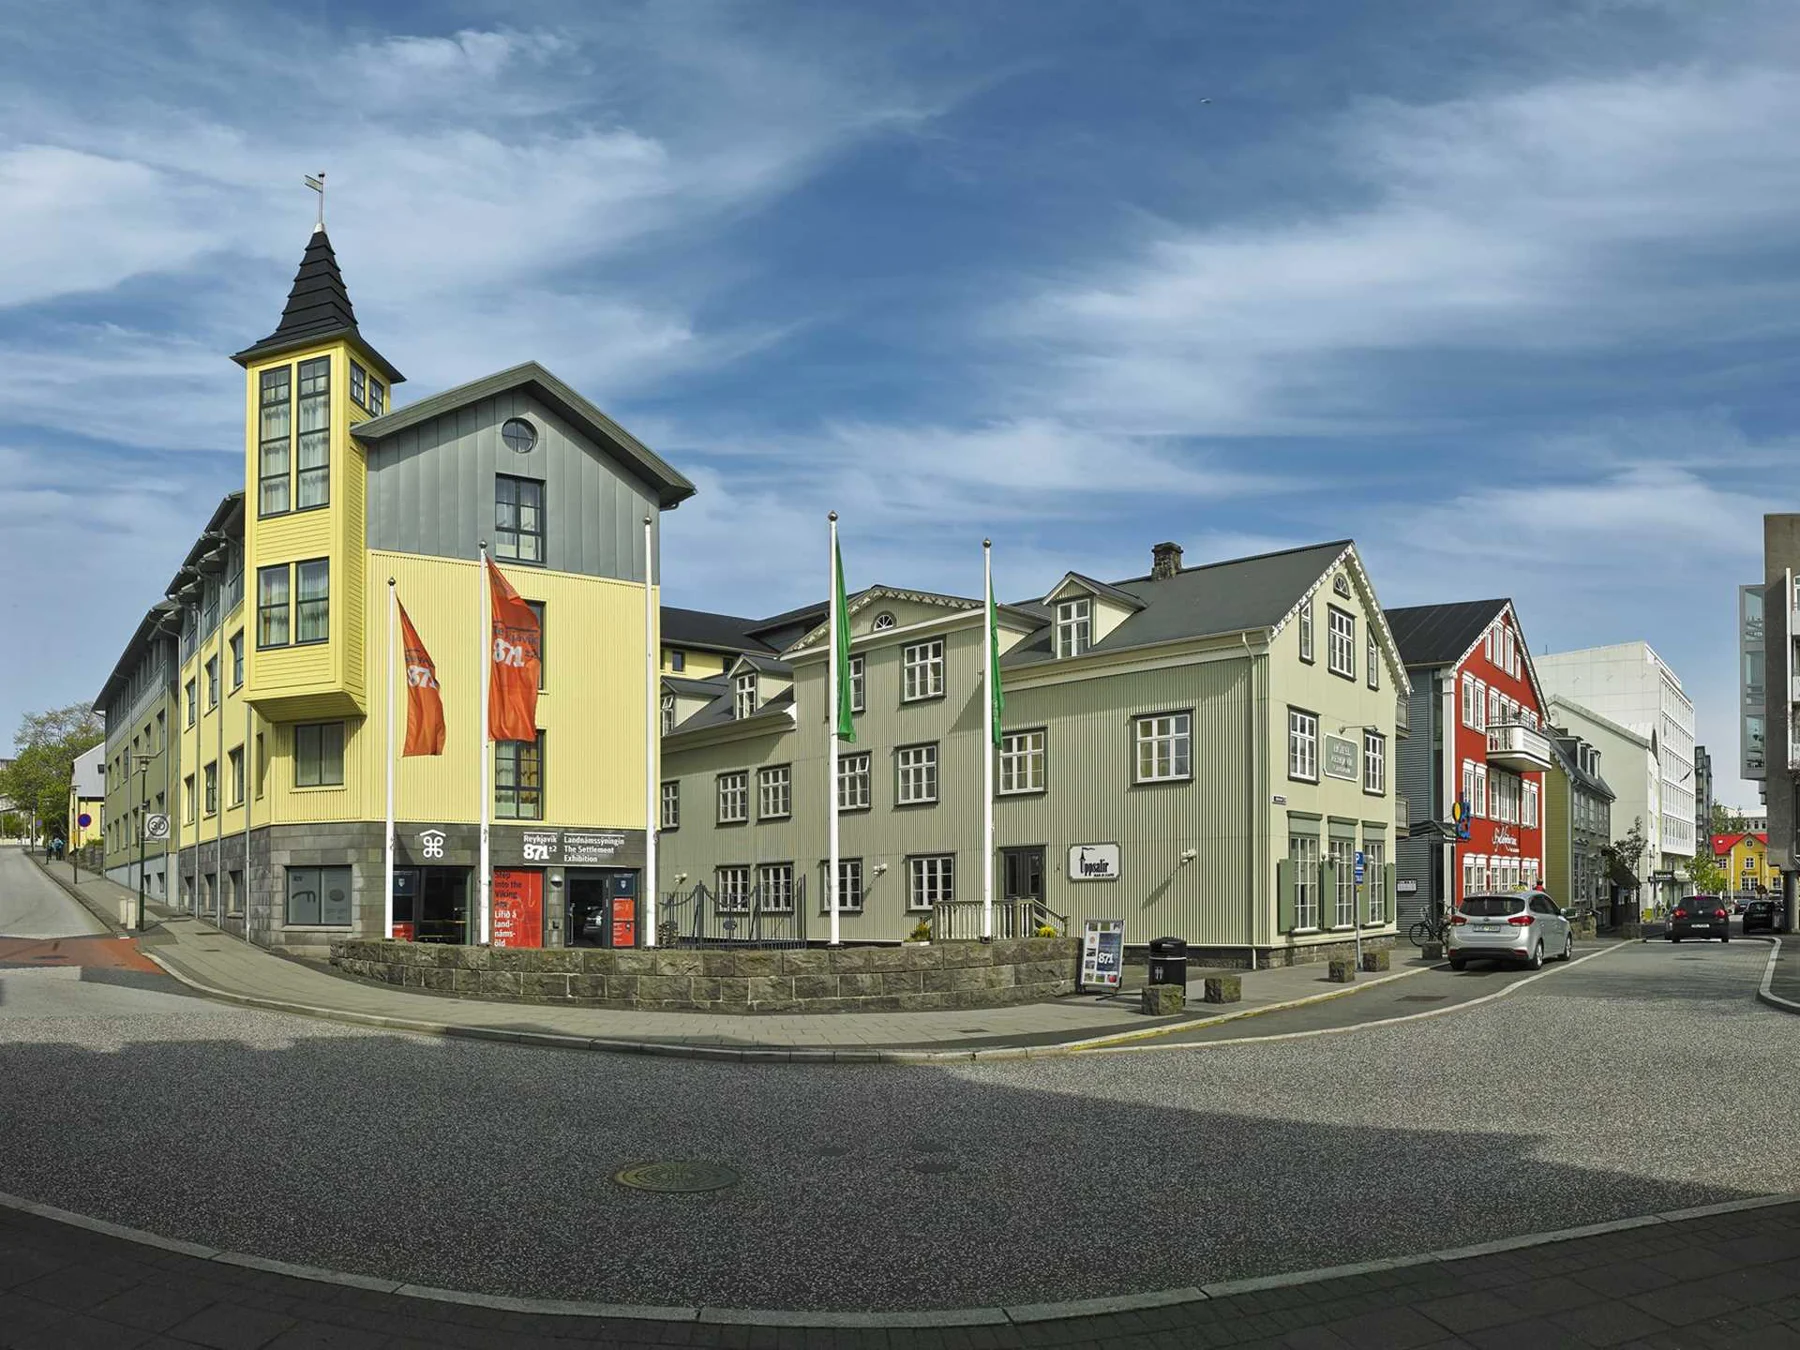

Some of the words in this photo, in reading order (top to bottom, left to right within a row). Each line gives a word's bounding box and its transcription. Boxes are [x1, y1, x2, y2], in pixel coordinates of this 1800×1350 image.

[151, 821, 166, 831] 30
[564, 845, 576, 853] The
[578, 845, 615, 854] Settlement
[564, 854, 598, 862] Exhibition
